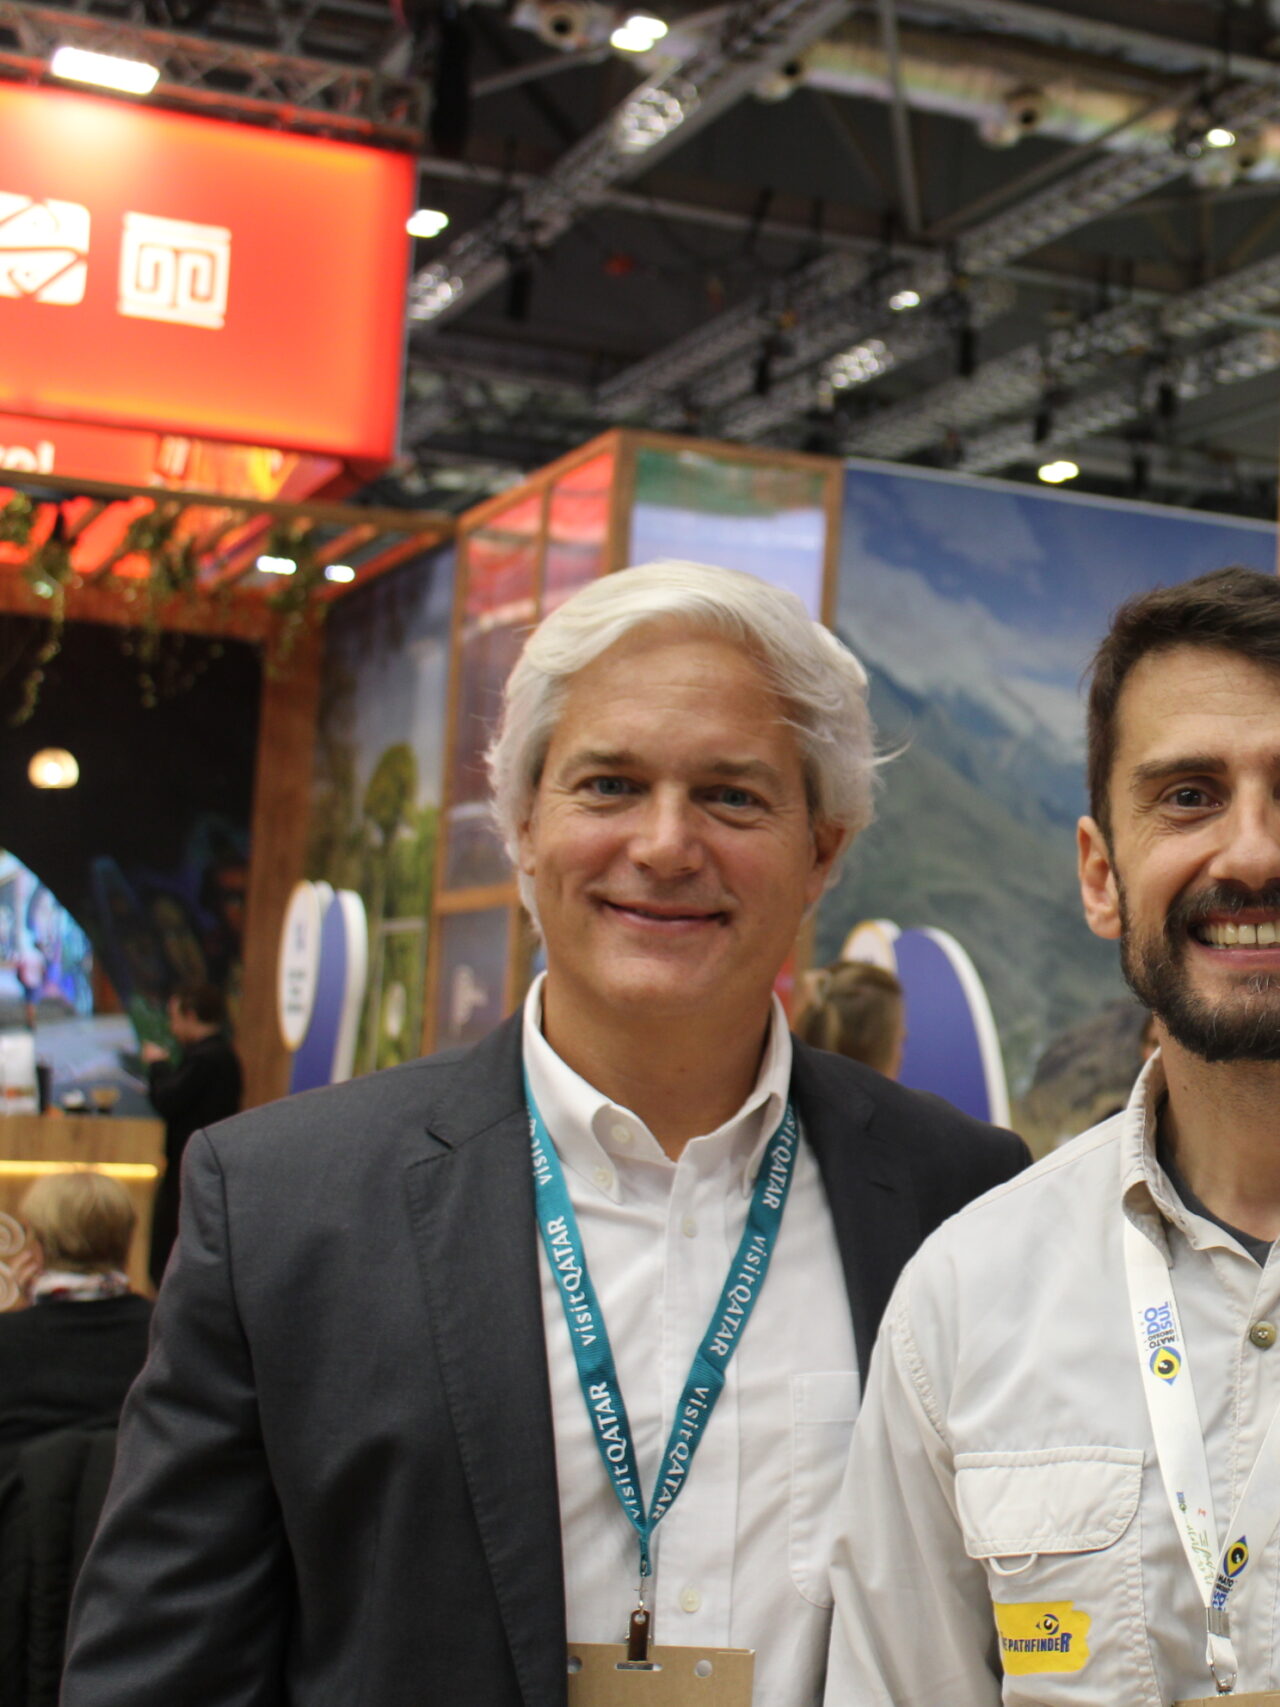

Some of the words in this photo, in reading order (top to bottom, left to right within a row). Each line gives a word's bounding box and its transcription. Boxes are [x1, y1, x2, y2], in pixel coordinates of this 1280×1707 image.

[547, 1215, 597, 1347] visitQATAR
[709, 1235, 767, 1357] visitQATAR
[1144, 1307, 1161, 1335] DO
[589, 1381, 641, 1520] visitQATAR
[651, 1387, 710, 1520] visitQATAR
[1008, 1632, 1073, 1652] PATHFINDER
